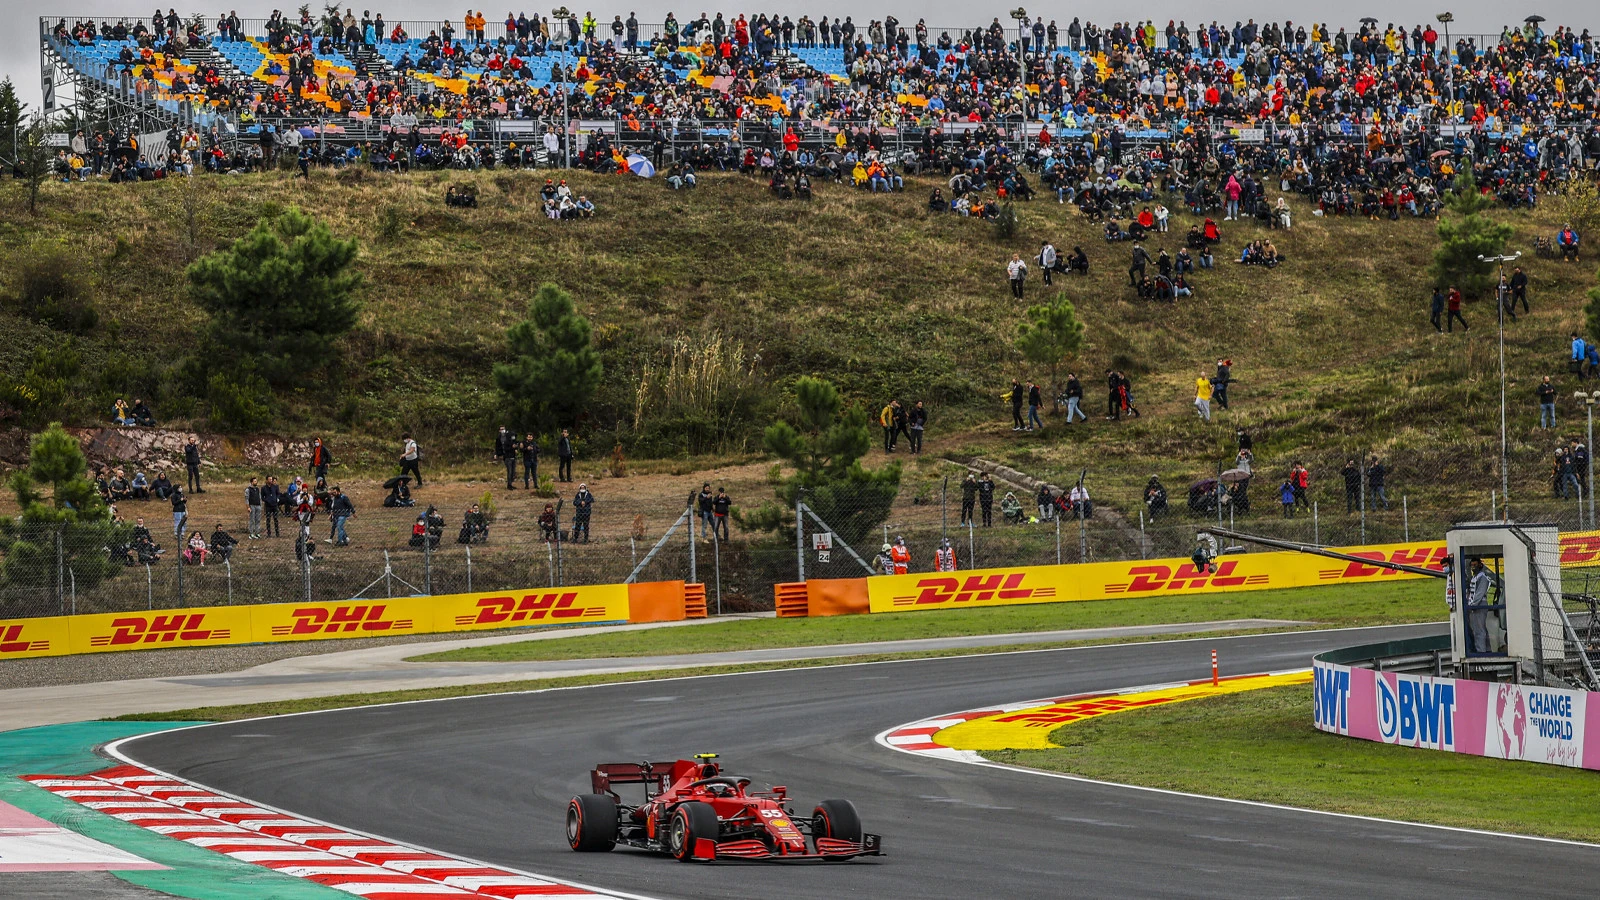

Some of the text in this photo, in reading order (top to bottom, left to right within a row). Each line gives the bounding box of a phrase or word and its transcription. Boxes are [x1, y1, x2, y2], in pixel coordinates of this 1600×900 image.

[43, 77, 53, 110] 2
[915, 573, 1034, 605] DHL
[1127, 561, 1247, 592] DHL
[291, 605, 394, 635] DHL
[475, 592, 585, 624] DHL
[110, 614, 212, 645] DHL
[992, 699, 1175, 723] DHL
[1313, 666, 1350, 729] BWT
[1399, 680, 1454, 745] BWT
[1529, 692, 1572, 718] CHANGE
[1530, 717, 1573, 741] THE WORLD
[760, 809, 783, 818] 55
